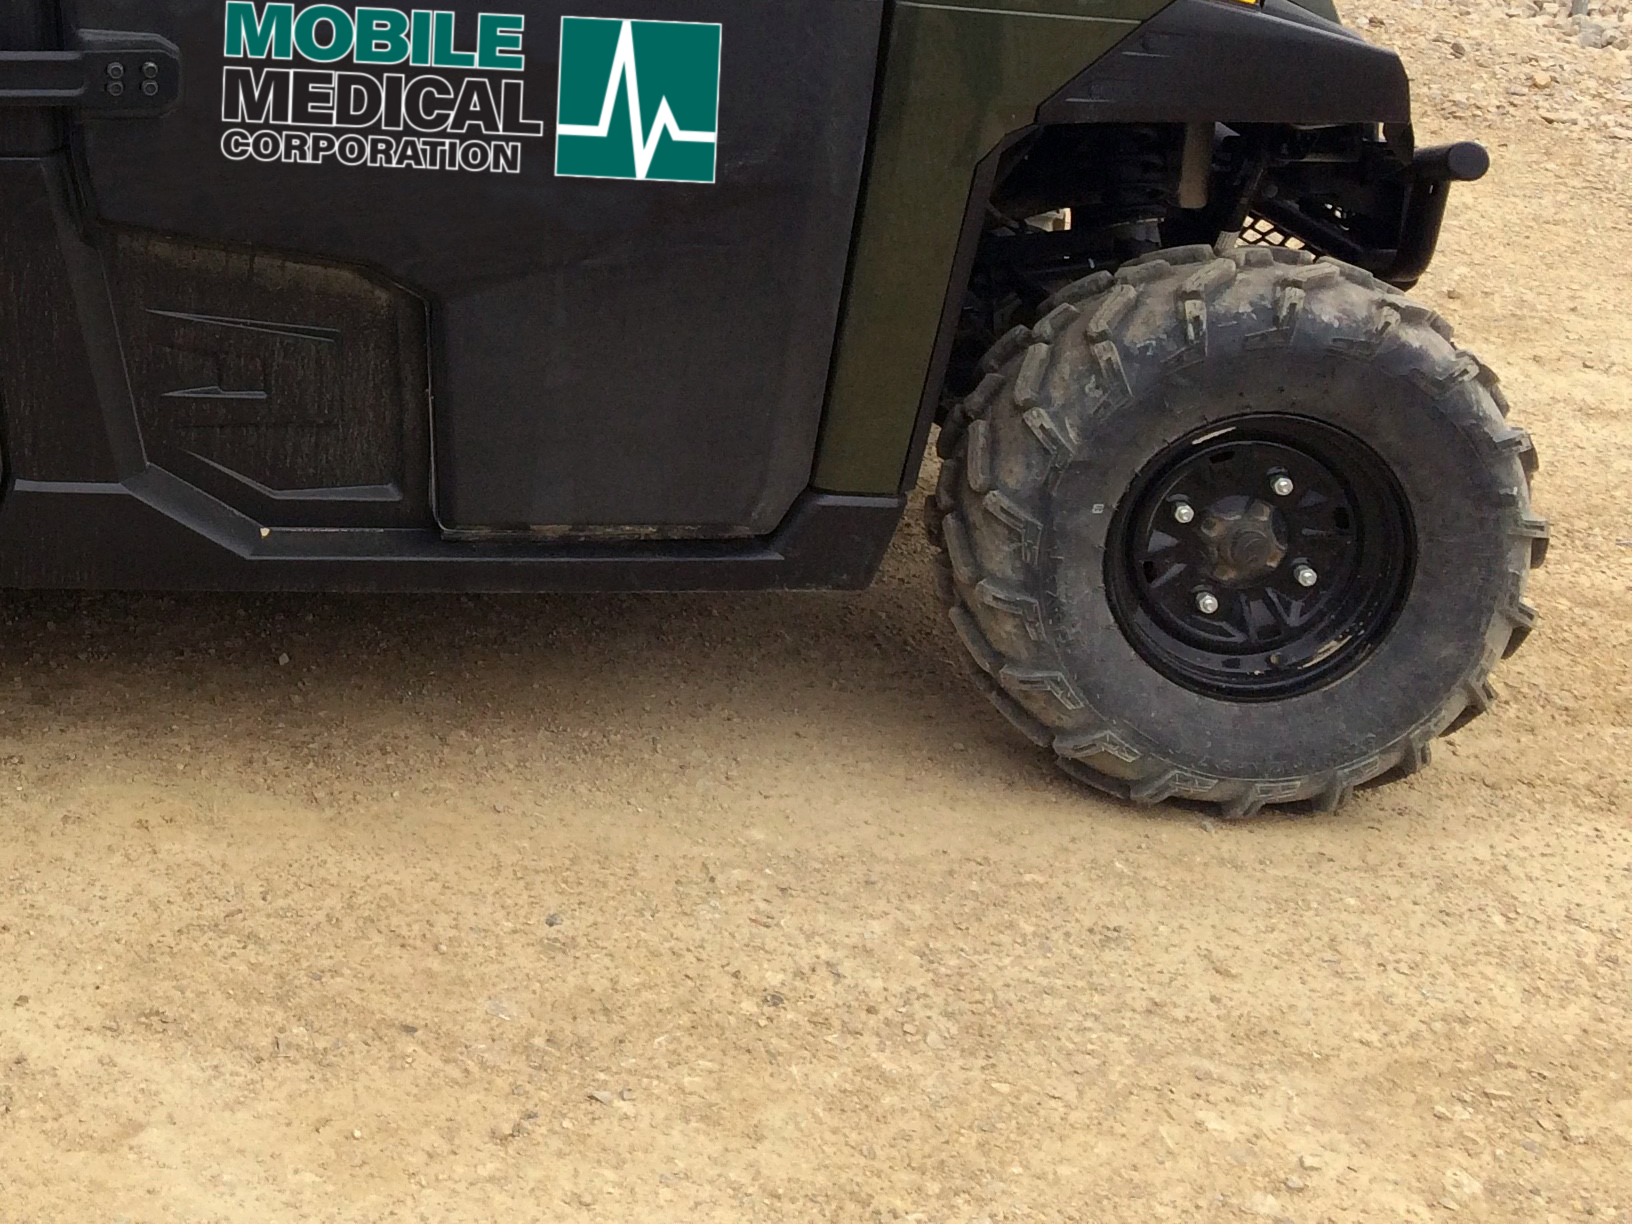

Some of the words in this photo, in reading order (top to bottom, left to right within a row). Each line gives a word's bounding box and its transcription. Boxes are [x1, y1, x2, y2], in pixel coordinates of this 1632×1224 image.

[223, 0, 525, 71] MOBILE
[221, 66, 544, 136] MEDICAL
[220, 129, 521, 173] CORPORATION
